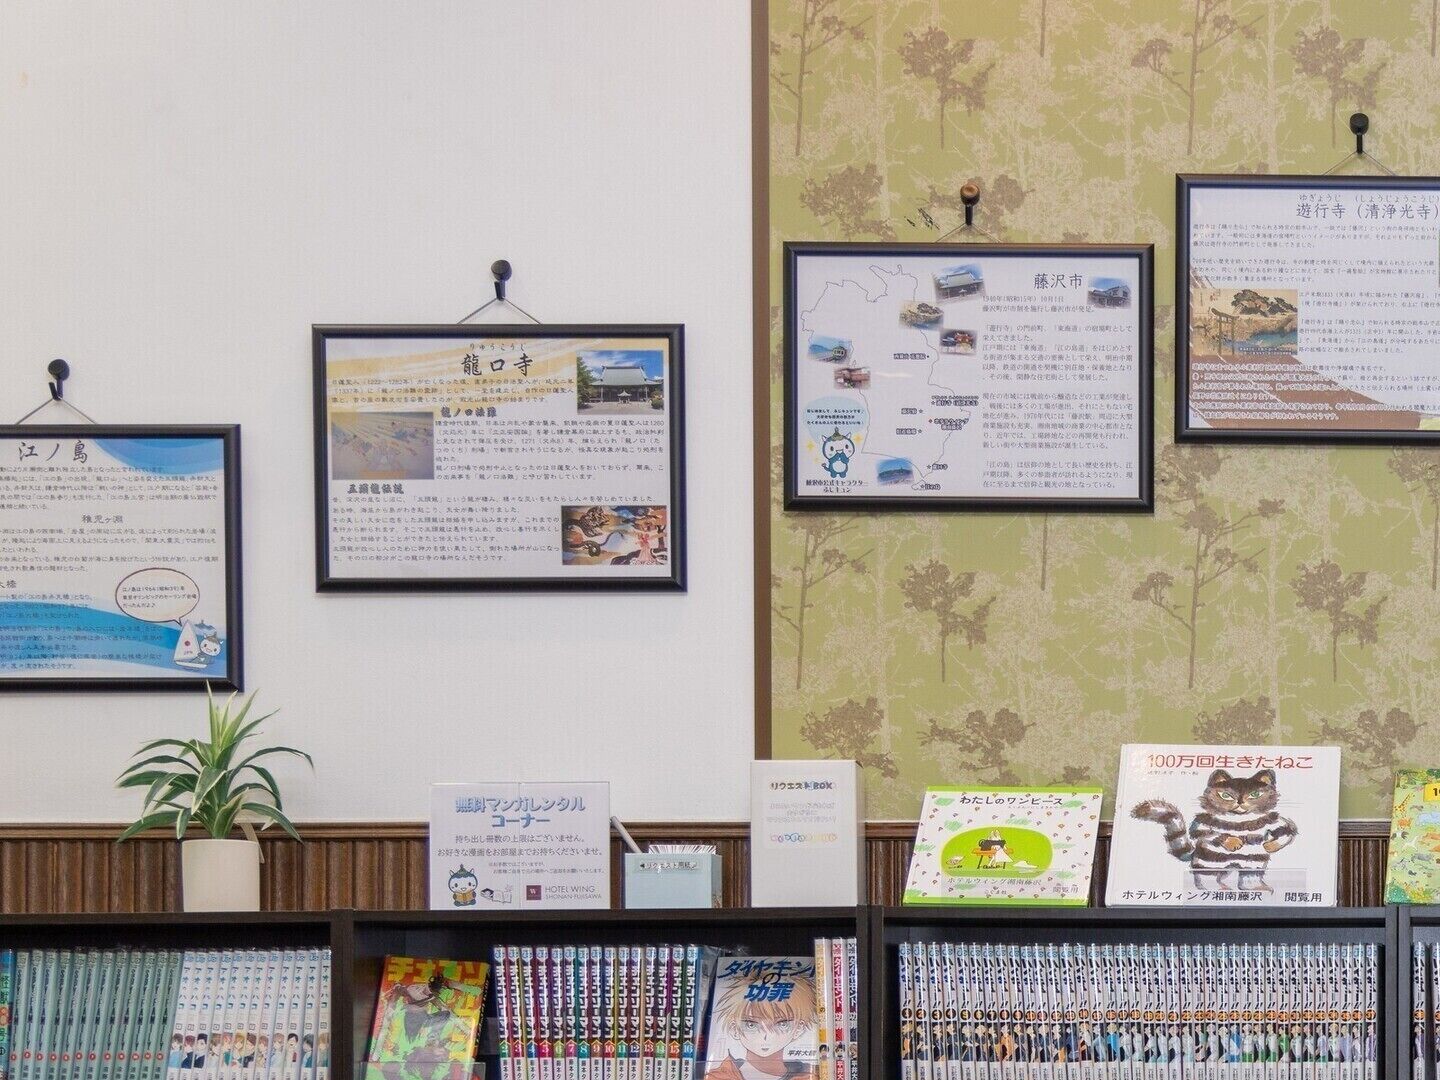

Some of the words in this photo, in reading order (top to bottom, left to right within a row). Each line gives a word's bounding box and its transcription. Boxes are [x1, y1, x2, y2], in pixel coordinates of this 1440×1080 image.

[1297, 203, 1346, 220] 遊行寺
[1033, 273, 1083, 289] 藤沢市
[461, 353, 533, 376] 龍口寺
[19, 440, 88, 463] 江ノ島
[1148, 754, 1313, 769] 100万回生きたねこ
[455, 796, 586, 813] 無料マンガレンタル
[959, 795, 1064, 806] わたしのワンピース
[491, 814, 551, 829] コーナー
[455, 834, 586, 844] 持ち出し冊数の上限はございません。
[545, 885, 568, 893] HOTEL
[571, 885, 595, 893] WING
[1053, 885, 1079, 894] 閲覧用
[1122, 891, 1263, 902] ホテルウィング湘南藤沢
[1284, 892, 1322, 902] 閲覧用
[762, 972, 781, 984] の
[744, 983, 796, 1001] 功罪
